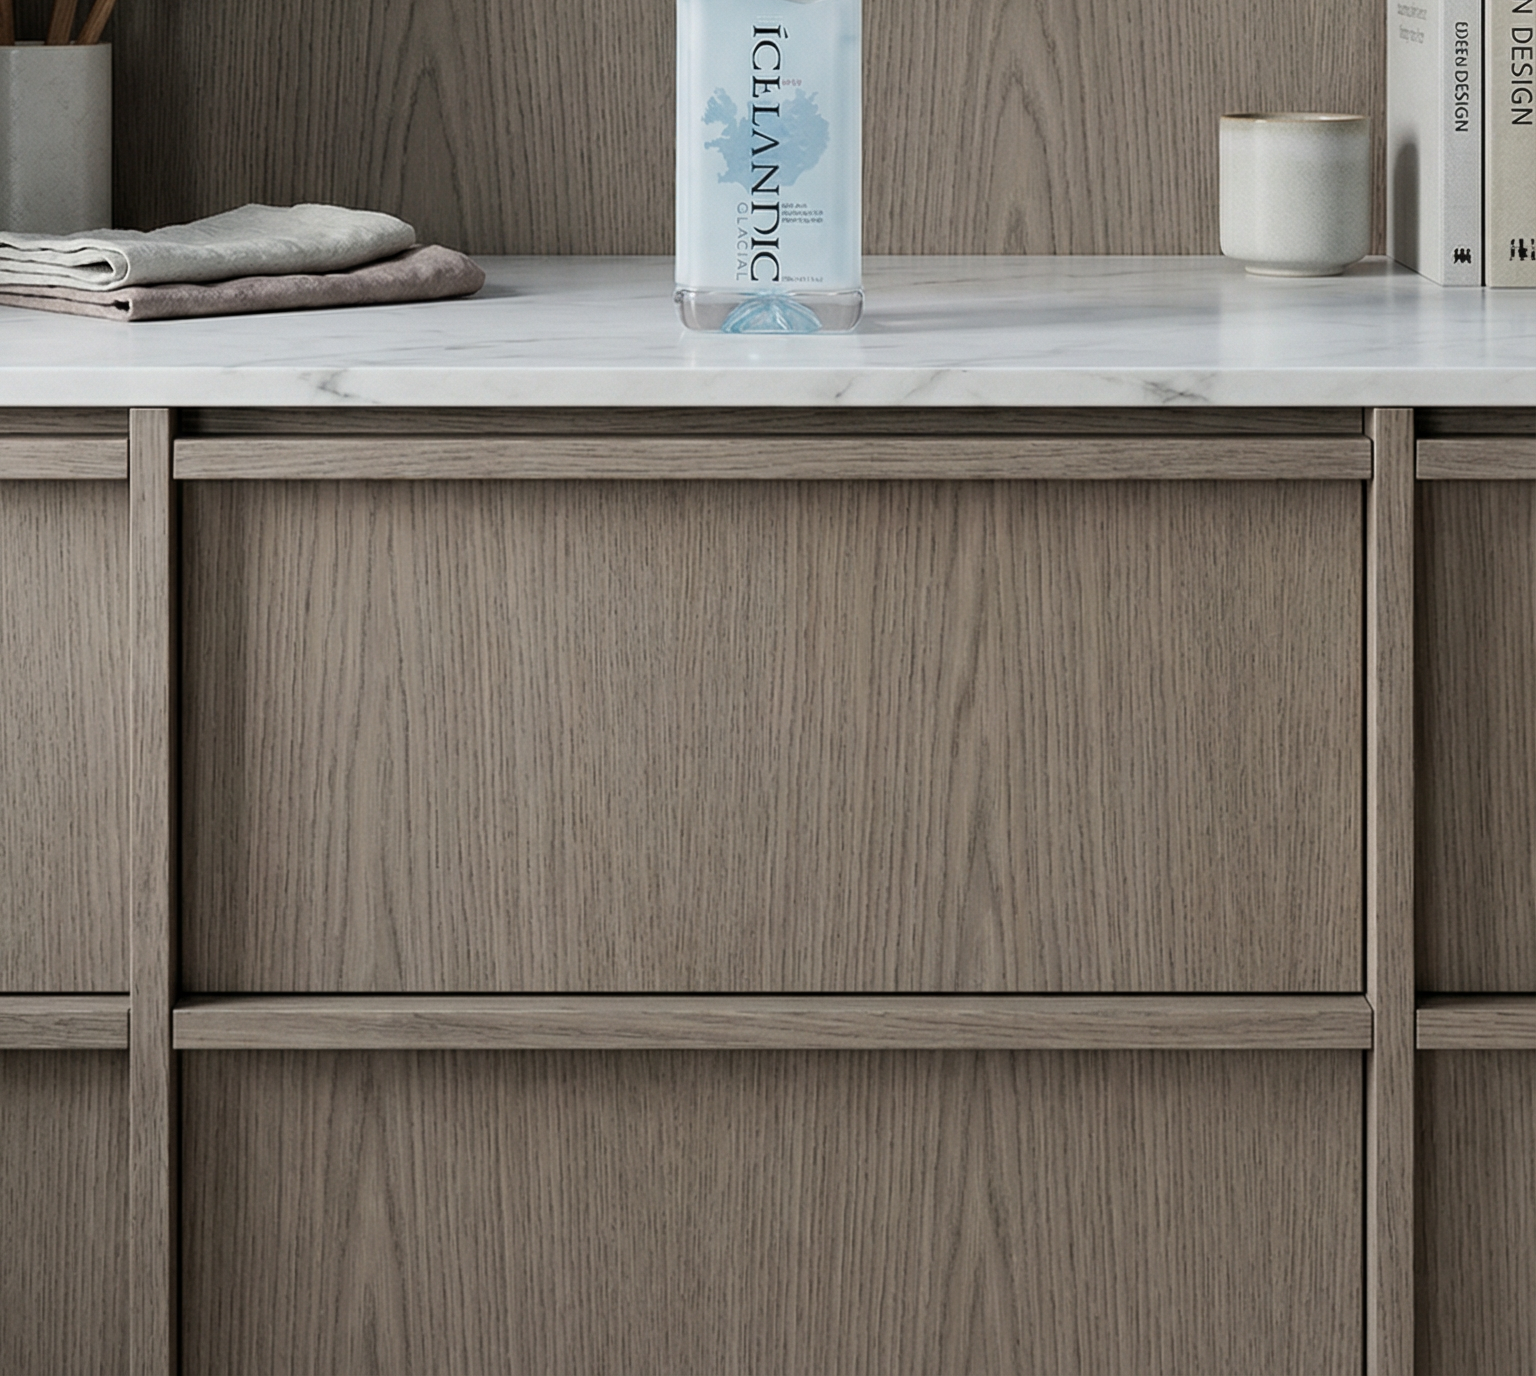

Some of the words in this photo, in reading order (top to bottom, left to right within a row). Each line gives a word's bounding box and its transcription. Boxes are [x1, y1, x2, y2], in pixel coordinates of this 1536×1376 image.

[1455, 70, 1469, 132] DESIGN
[1511, 27, 1534, 125] DESIGN
[736, 202, 749, 281] GLACIAL
